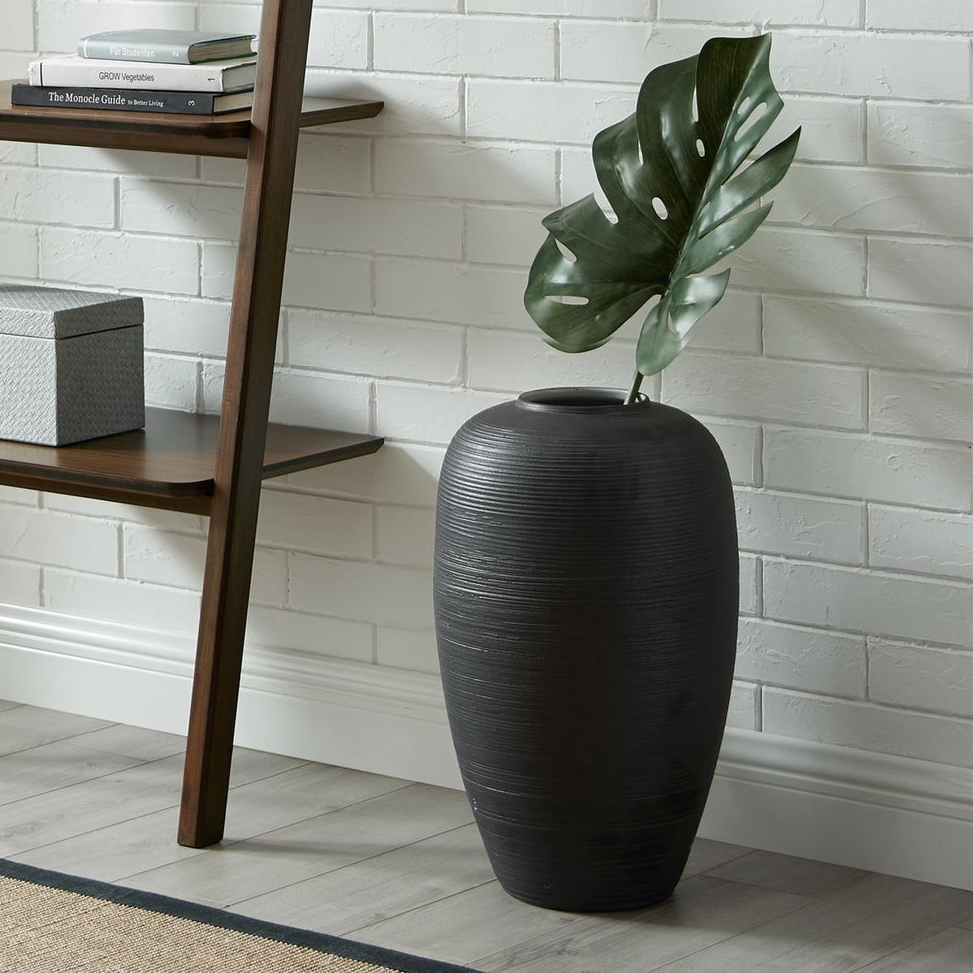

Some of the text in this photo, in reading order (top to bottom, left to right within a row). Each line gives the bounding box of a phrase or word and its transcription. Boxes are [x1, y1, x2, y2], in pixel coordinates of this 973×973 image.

[121, 46, 155, 58] Studenten
[98, 71, 155, 83] GROW Vegetables
[48, 91, 64, 102] The
[65, 92, 100, 104] Monocle
[101, 94, 126, 105] Guide
[133, 98, 148, 106] Better
[148, 99, 164, 108] Living
